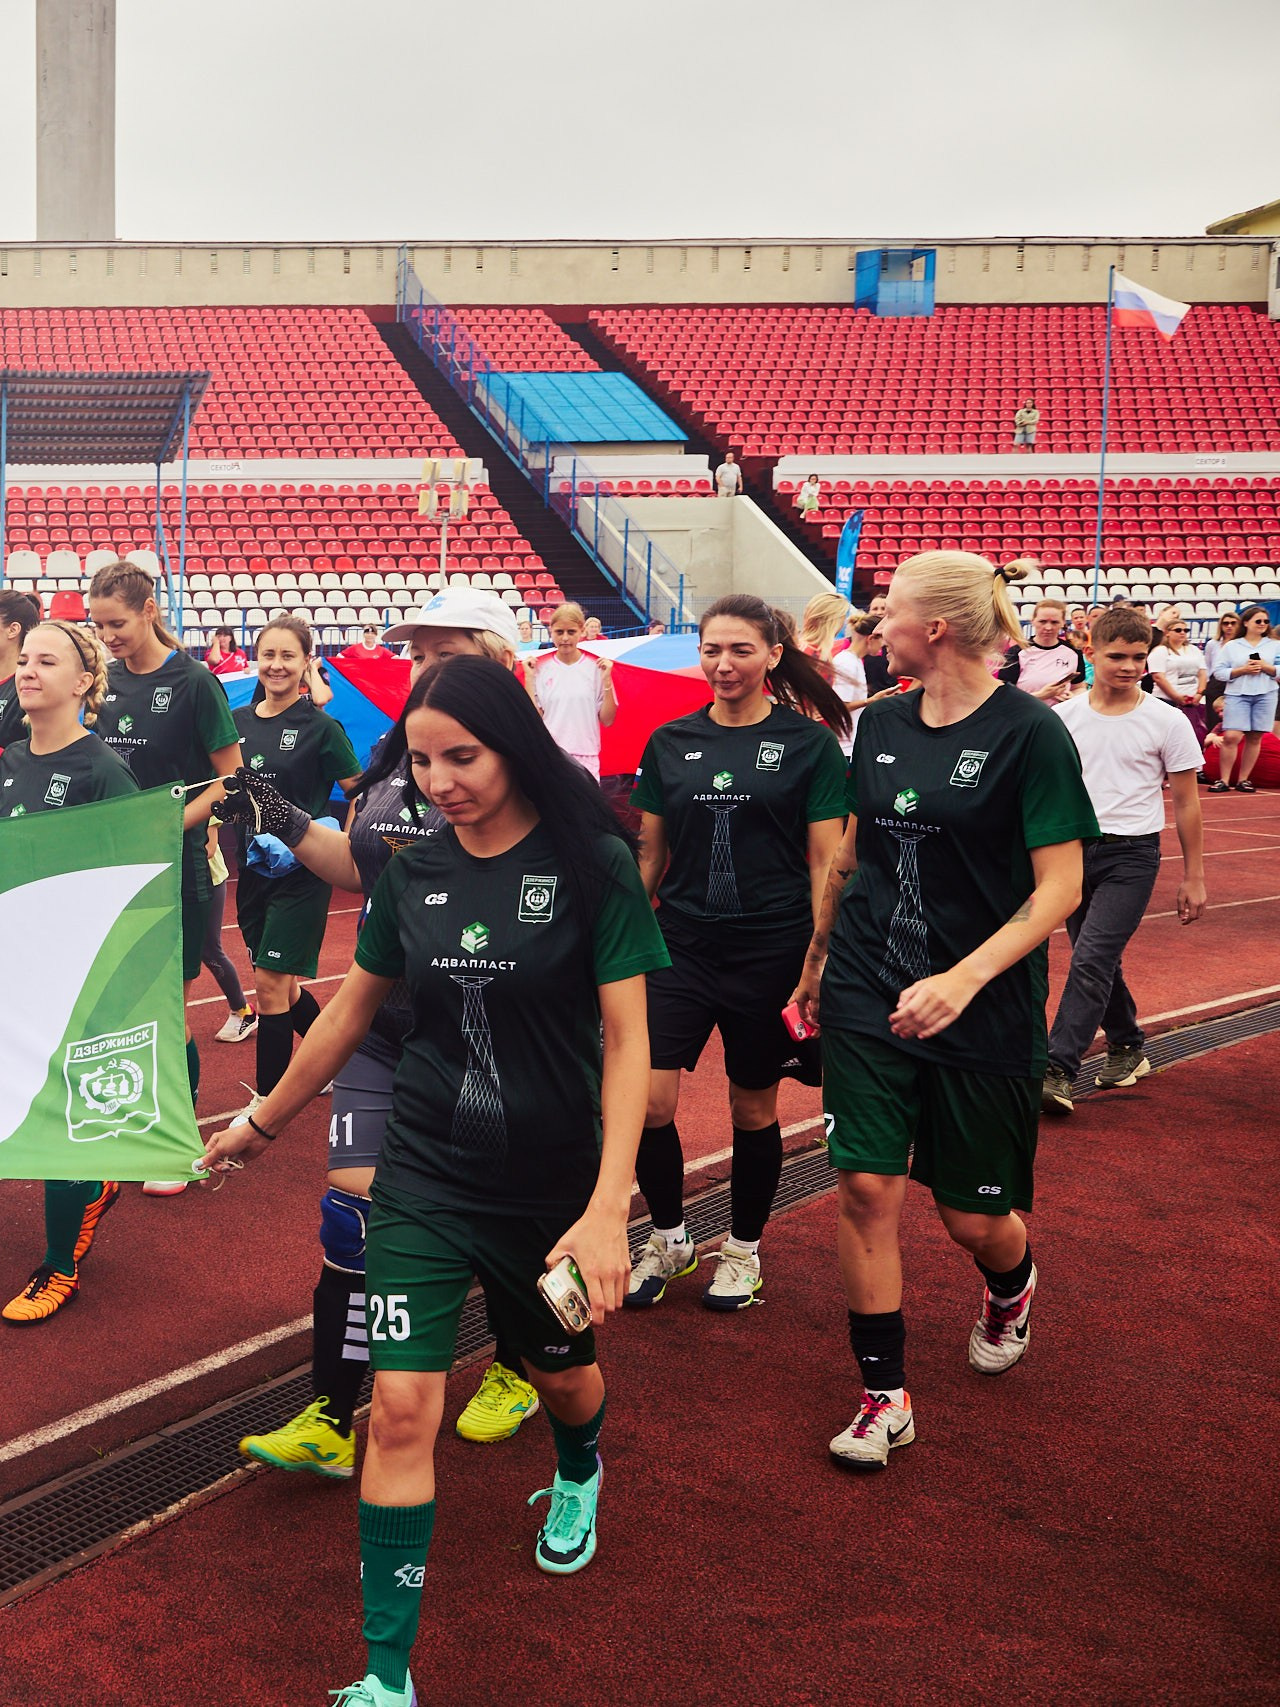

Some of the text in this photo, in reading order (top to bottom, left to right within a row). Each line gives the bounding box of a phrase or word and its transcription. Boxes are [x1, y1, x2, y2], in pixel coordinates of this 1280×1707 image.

[104, 736, 148, 745] АДВАПЛАСТ
[684, 751, 703, 761] GS
[876, 753, 896, 764] GS
[369, 822, 439, 837] АДВАПЛАС
[874, 816, 942, 833] АДВАПЛАСТ
[424, 892, 449, 906] GS
[267, 950, 281, 959] GS
[430, 957, 517, 971] АДВАПЛАСТ
[73, 1029, 150, 1059] ДЗЕРЖИНСК
[328, 1112, 353, 1148] 41
[977, 1185, 1002, 1195] GS
[369, 1294, 411, 1341] 25
[544, 1345, 571, 1355] GS
